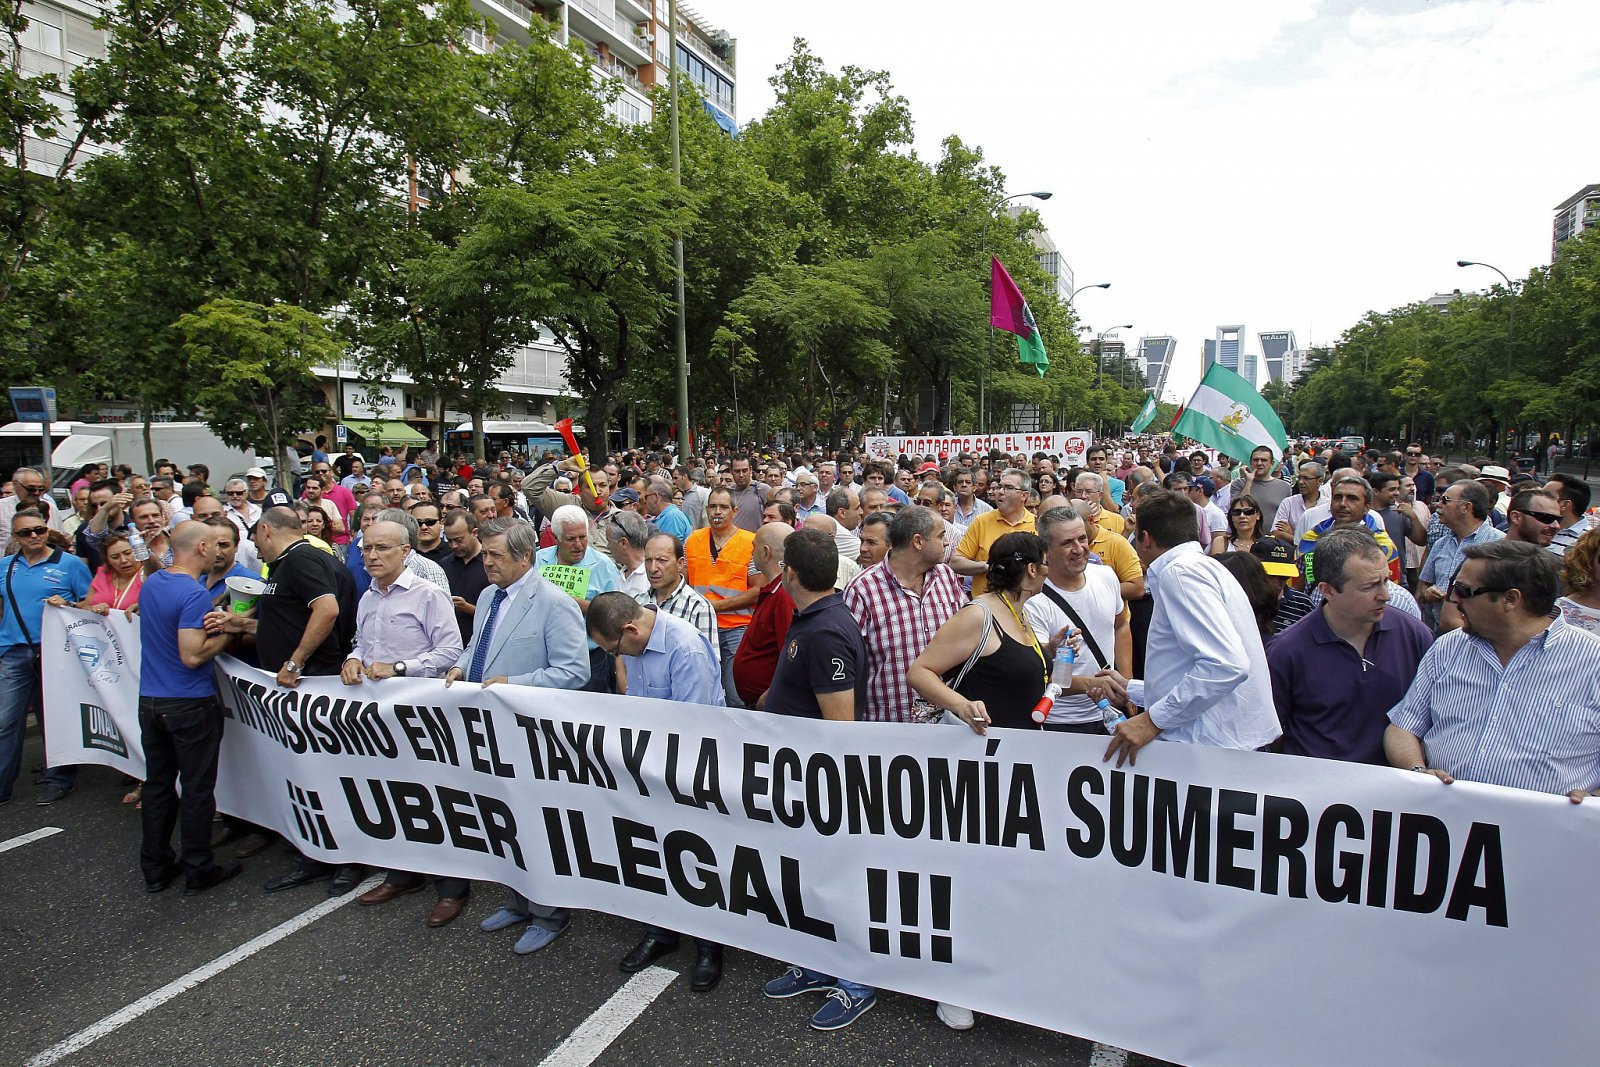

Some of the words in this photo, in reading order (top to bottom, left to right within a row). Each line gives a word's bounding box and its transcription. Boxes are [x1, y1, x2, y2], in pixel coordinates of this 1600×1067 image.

[351, 393, 397, 408] ZAMORA
[1005, 436, 1020, 452] EL
[1025, 434, 1055, 451] TAXI
[542, 572, 583, 583] CONTRA
[545, 566, 584, 576] GUERRA
[831, 657, 846, 681] 2
[393, 703, 460, 767] EN
[458, 706, 516, 779] EL
[514, 712, 619, 791] TAXI
[619, 726, 653, 798] Y
[665, 732, 731, 816] LA
[741, 738, 1047, 852] ECONOMÍA
[1065, 764, 1510, 929] SUMERGIDA
[338, 776, 528, 873] UBER
[541, 806, 839, 943] ILEGAL
